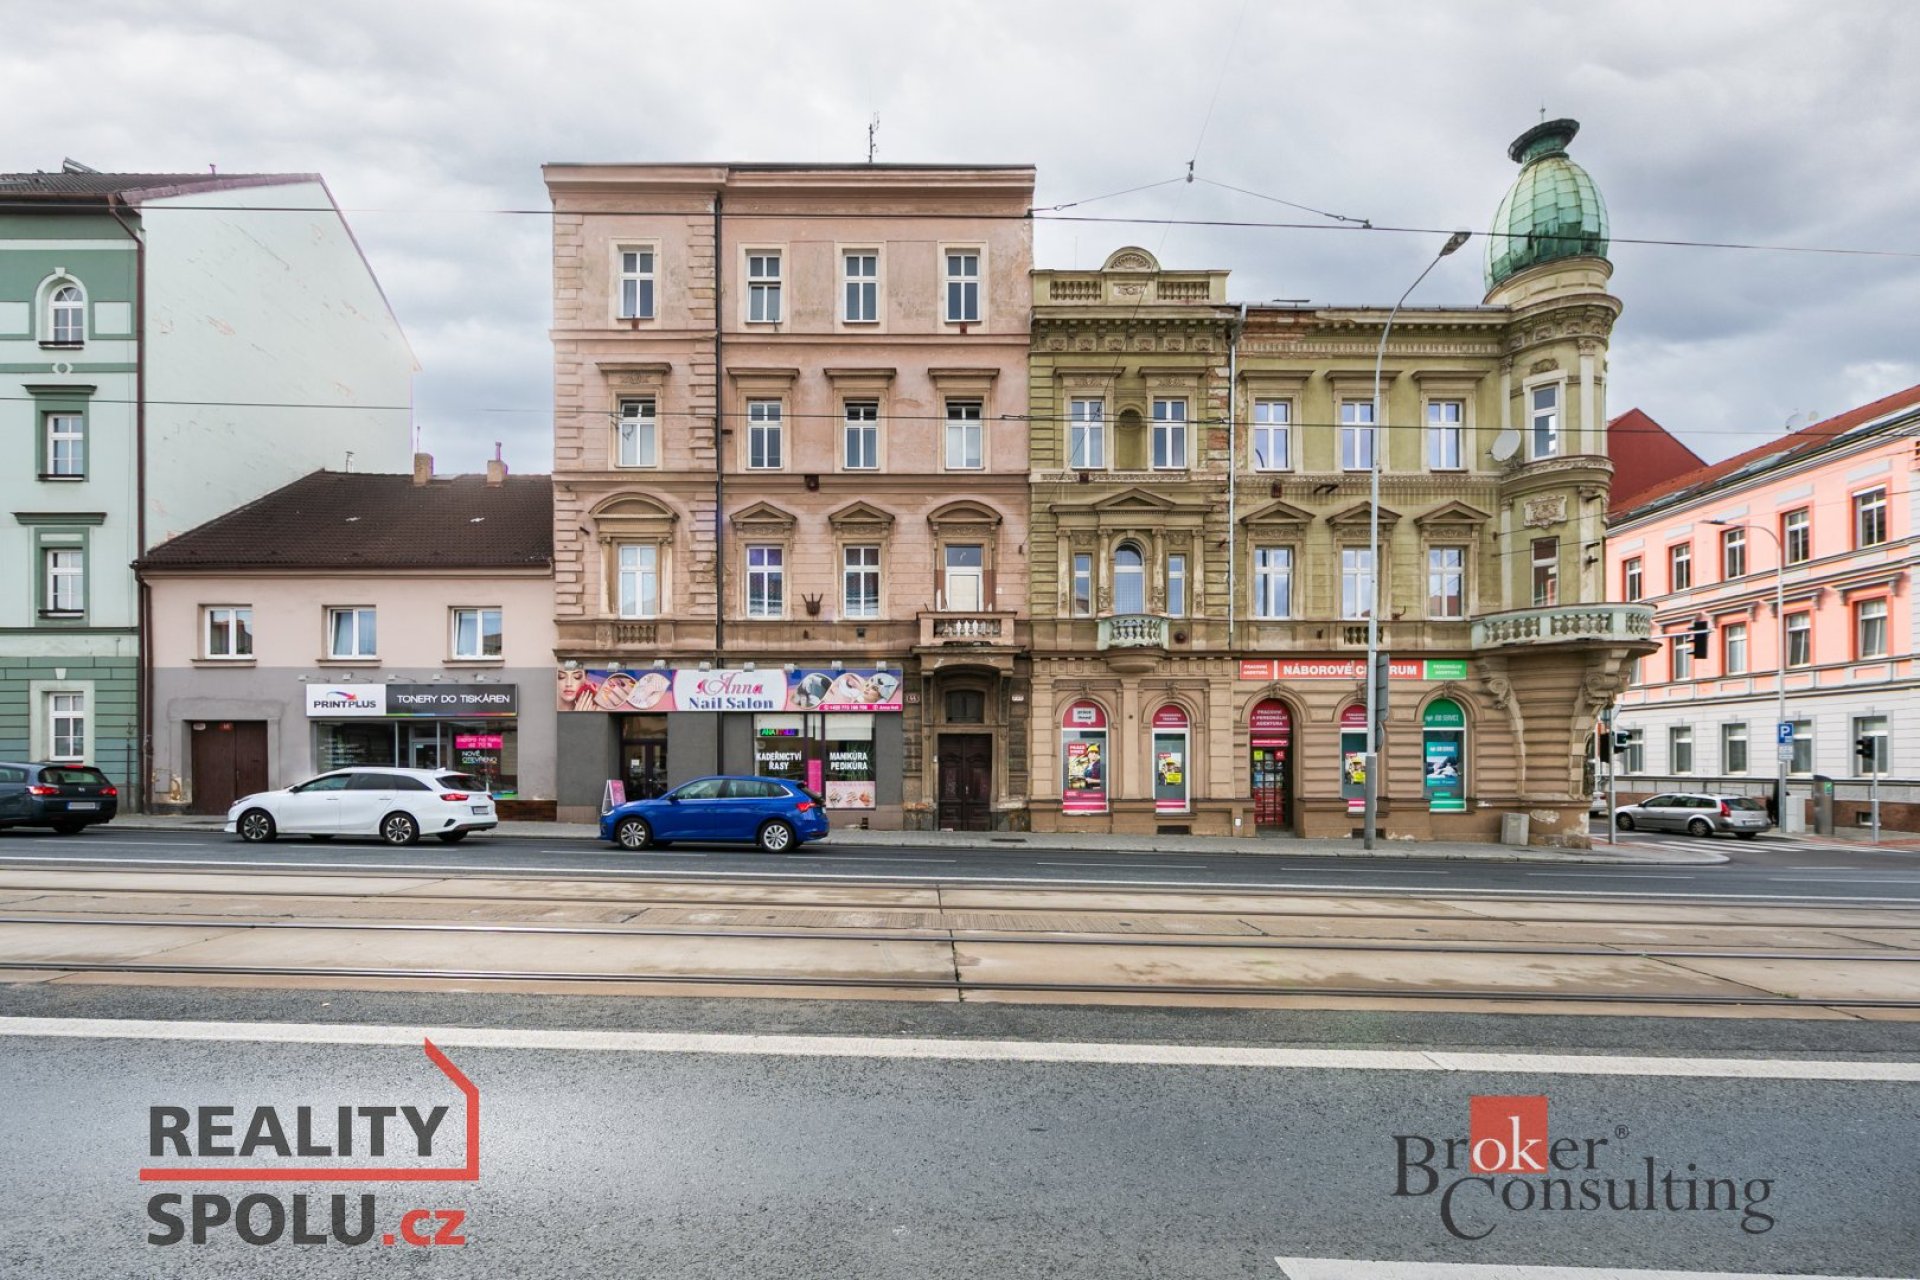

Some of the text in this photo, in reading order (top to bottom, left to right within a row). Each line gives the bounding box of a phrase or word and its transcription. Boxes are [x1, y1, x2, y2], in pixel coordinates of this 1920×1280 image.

[1283, 662, 1353, 675] NÁBOROVÉ
[696, 672, 764, 696] Anna
[396, 695, 438, 704] TONERY
[440, 695, 458, 704] DO
[689, 697, 774, 710] Nail Salon
[1780, 726, 1791, 738] P
[755, 750, 802, 761] KADEŘNICTVÍ
[829, 751, 869, 760] MANIKÚRA
[768, 760, 790, 770] ŘASY
[830, 761, 869, 770] PEDIKÚRA
